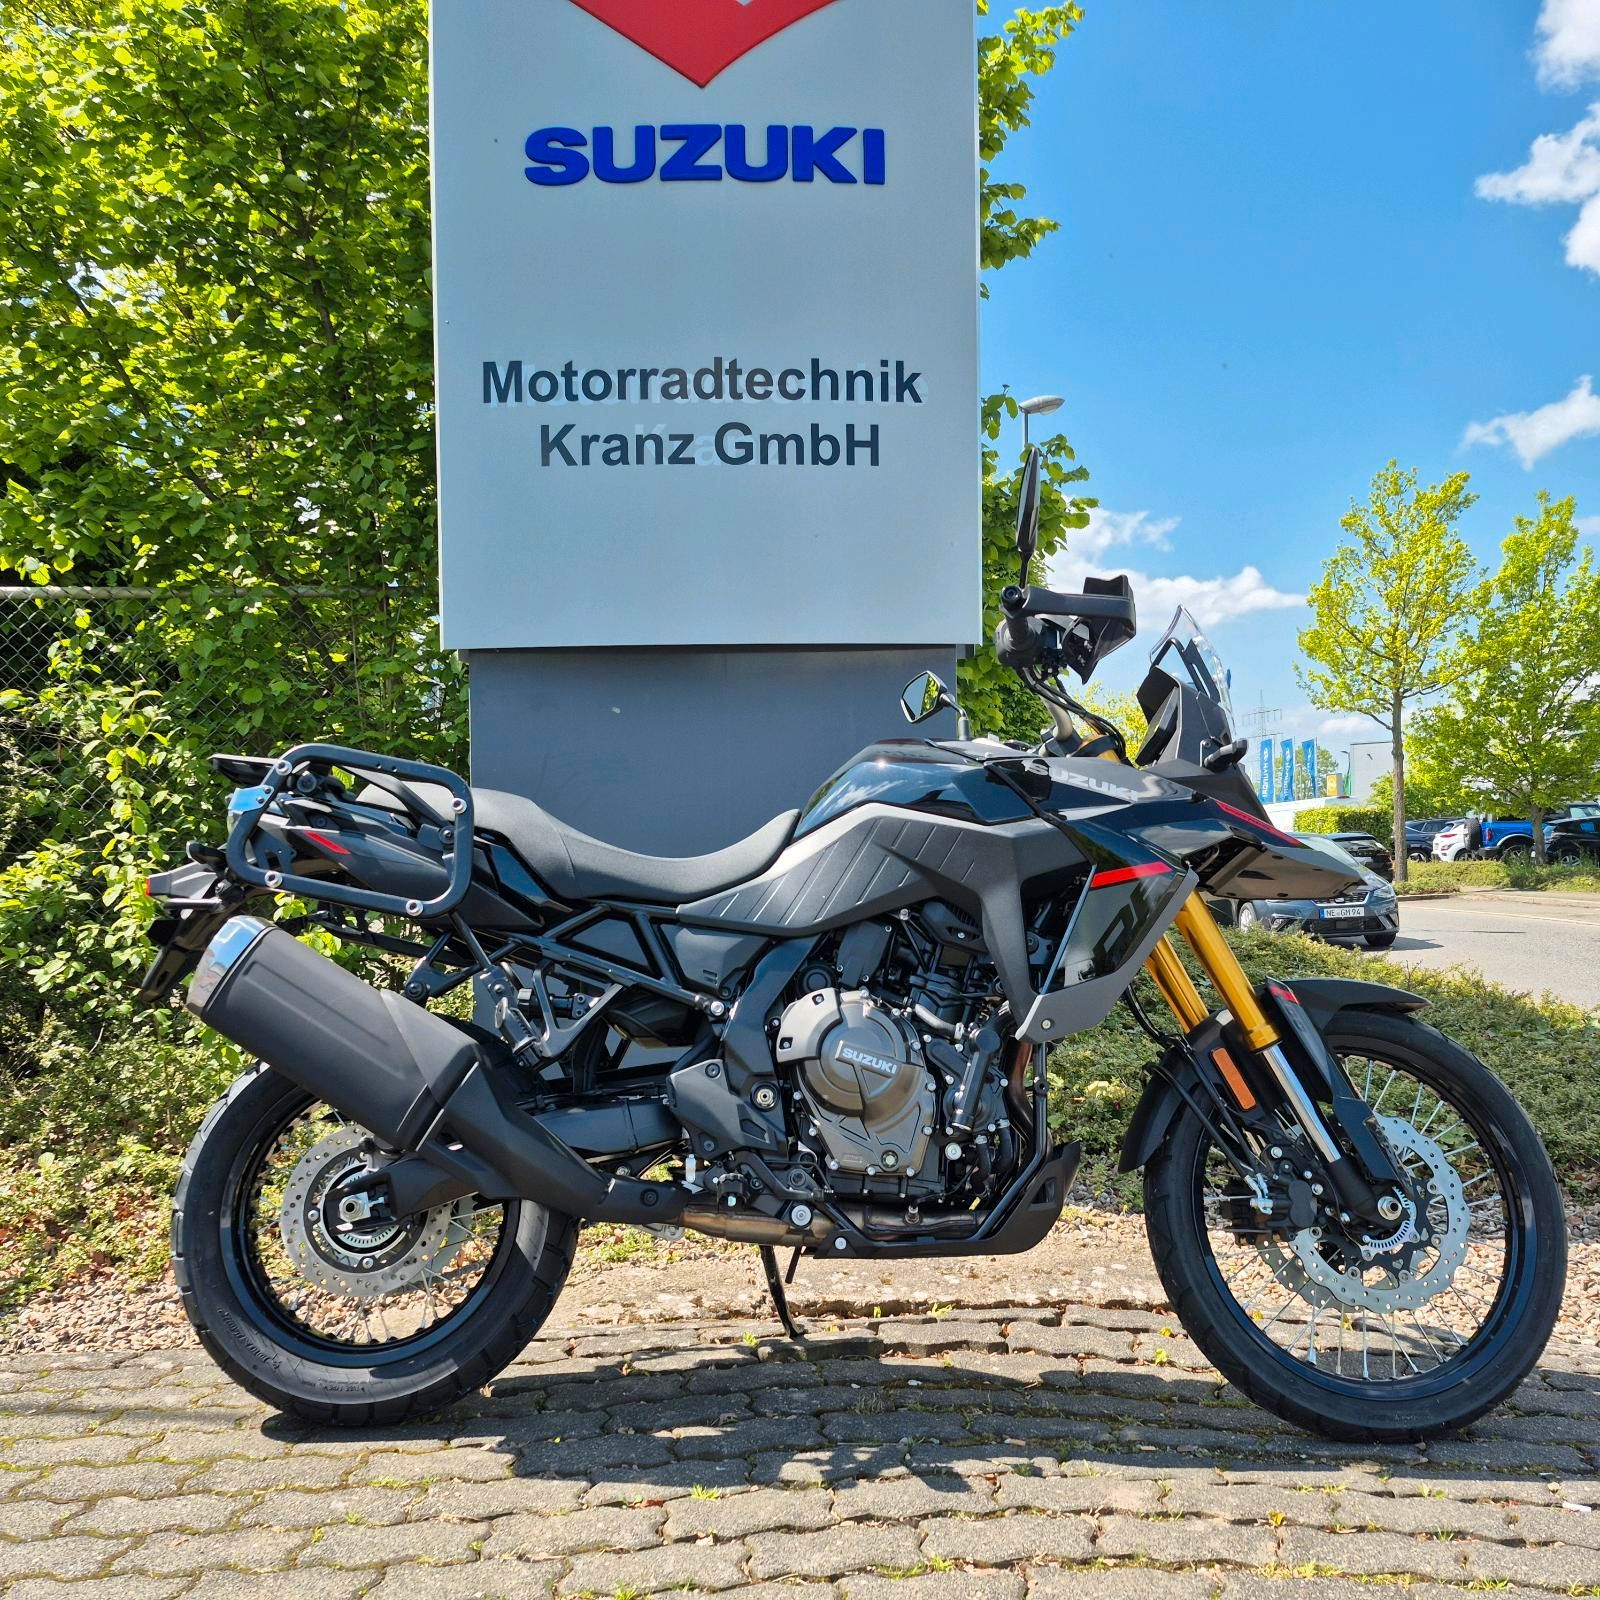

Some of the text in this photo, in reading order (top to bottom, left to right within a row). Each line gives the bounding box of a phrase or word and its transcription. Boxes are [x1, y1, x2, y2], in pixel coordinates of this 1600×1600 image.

[523, 123, 887, 185] SUZUKI
[482, 356, 923, 403] Motorradtechnik
[540, 421, 879, 466] Kranz GmbH
[1020, 759, 1138, 803] SUZUKI
[842, 1047, 898, 1074] SUZUKI
